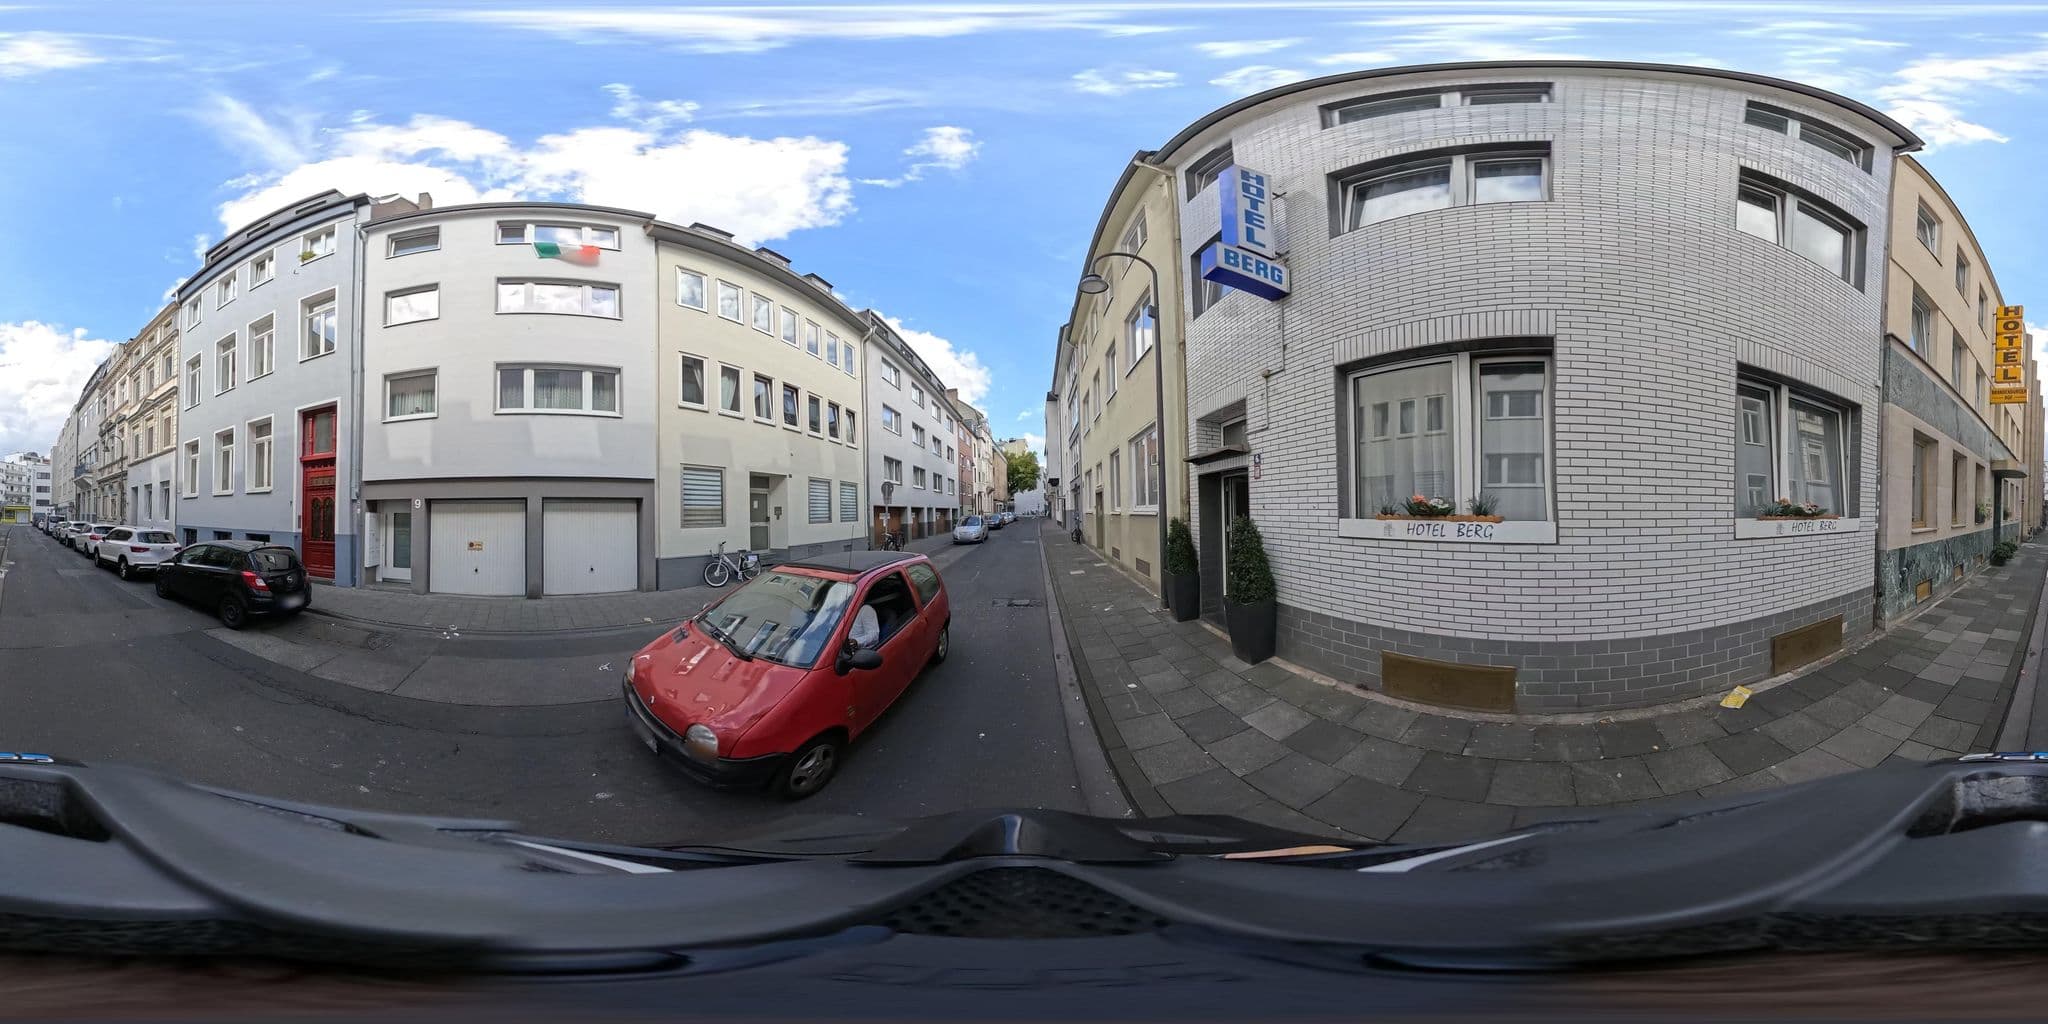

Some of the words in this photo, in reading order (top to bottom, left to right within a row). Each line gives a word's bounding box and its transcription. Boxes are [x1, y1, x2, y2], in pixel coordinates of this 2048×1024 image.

[1240, 169, 1266, 249] HOTEL
[1224, 248, 1283, 285] BERG
[2003, 306, 2020, 380] HOTEL
[414, 499, 421, 509] 9
[1407, 522, 1446, 538] HOTEL
[1456, 523, 1494, 541] BERG
[1791, 521, 1815, 533] HOTEL
[1820, 520, 1837, 531] BERG
